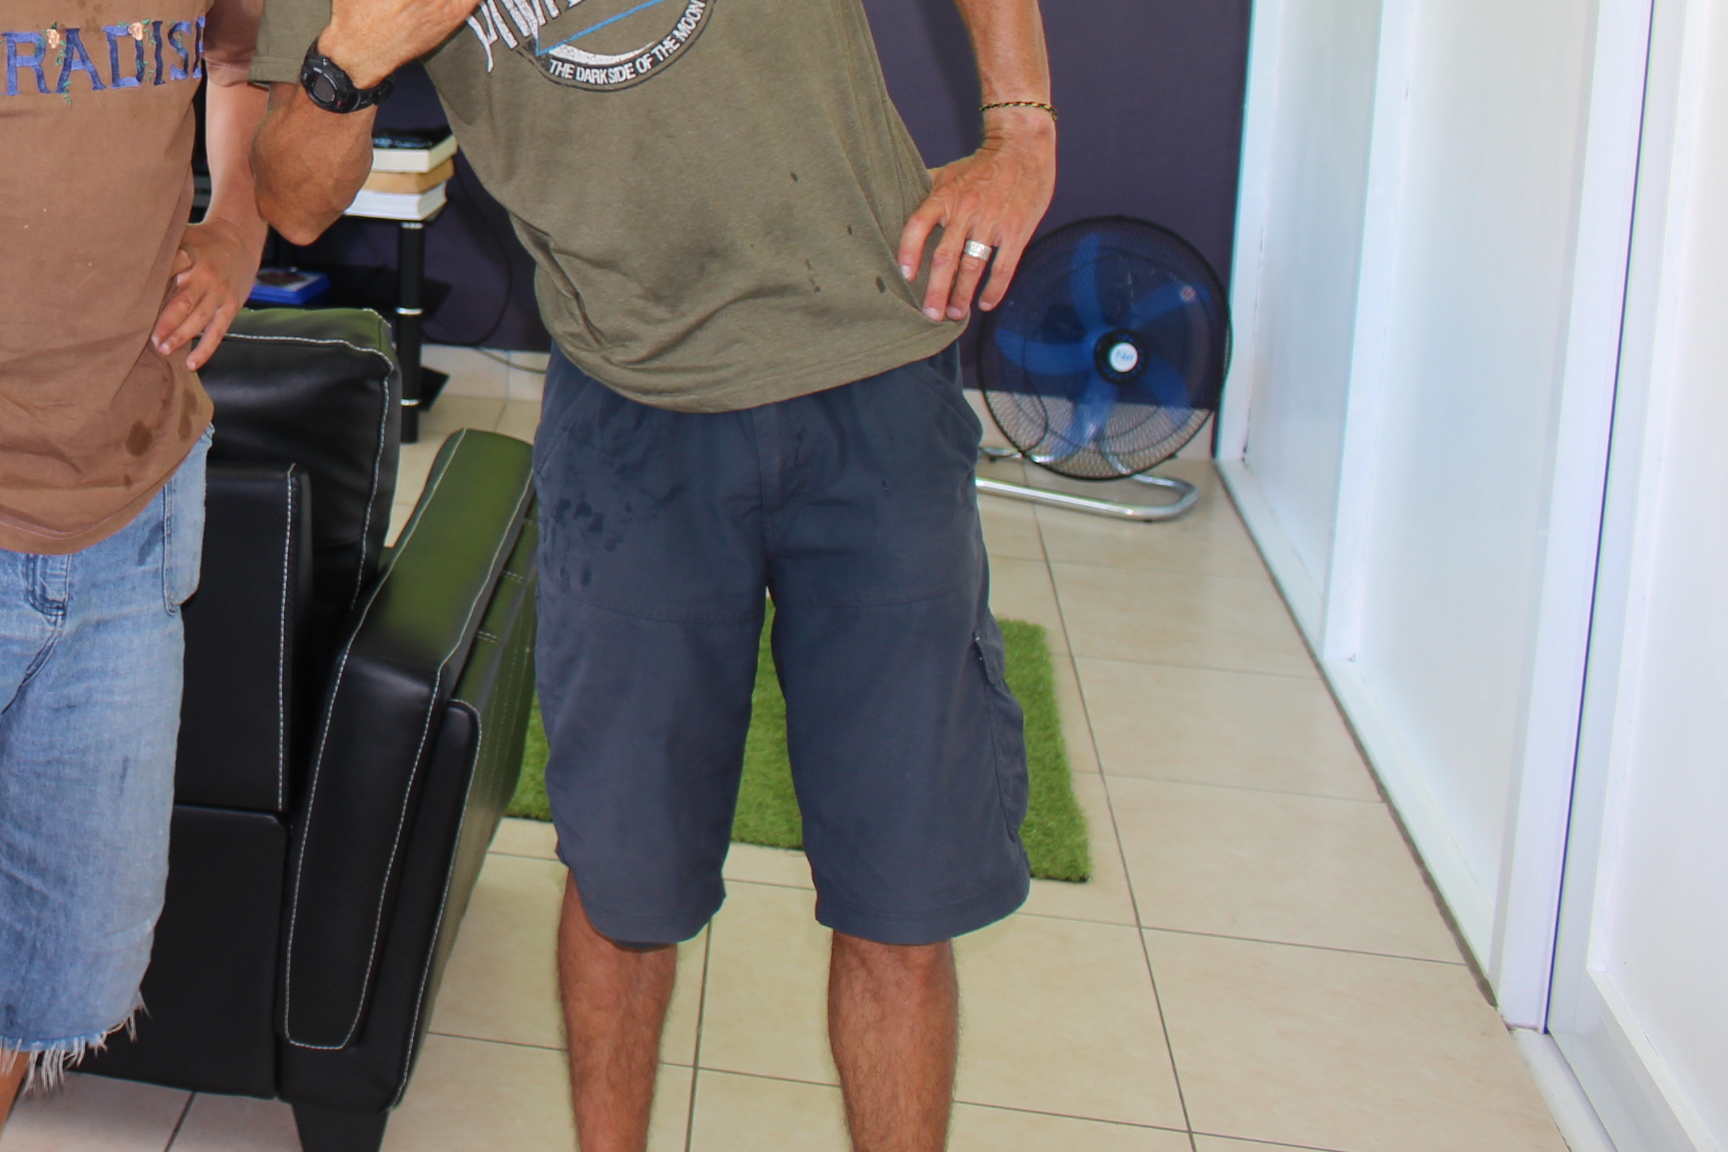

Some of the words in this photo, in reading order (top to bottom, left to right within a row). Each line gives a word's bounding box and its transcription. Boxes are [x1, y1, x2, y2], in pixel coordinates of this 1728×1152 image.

[549, 59, 573, 79] THE
[576, 67, 608, 85] DARK
[608, 62, 636, 84] SIDE
[635, 55, 655, 74] OF
[651, 36, 680, 61] THE
[673, 0, 706, 42] MOON
